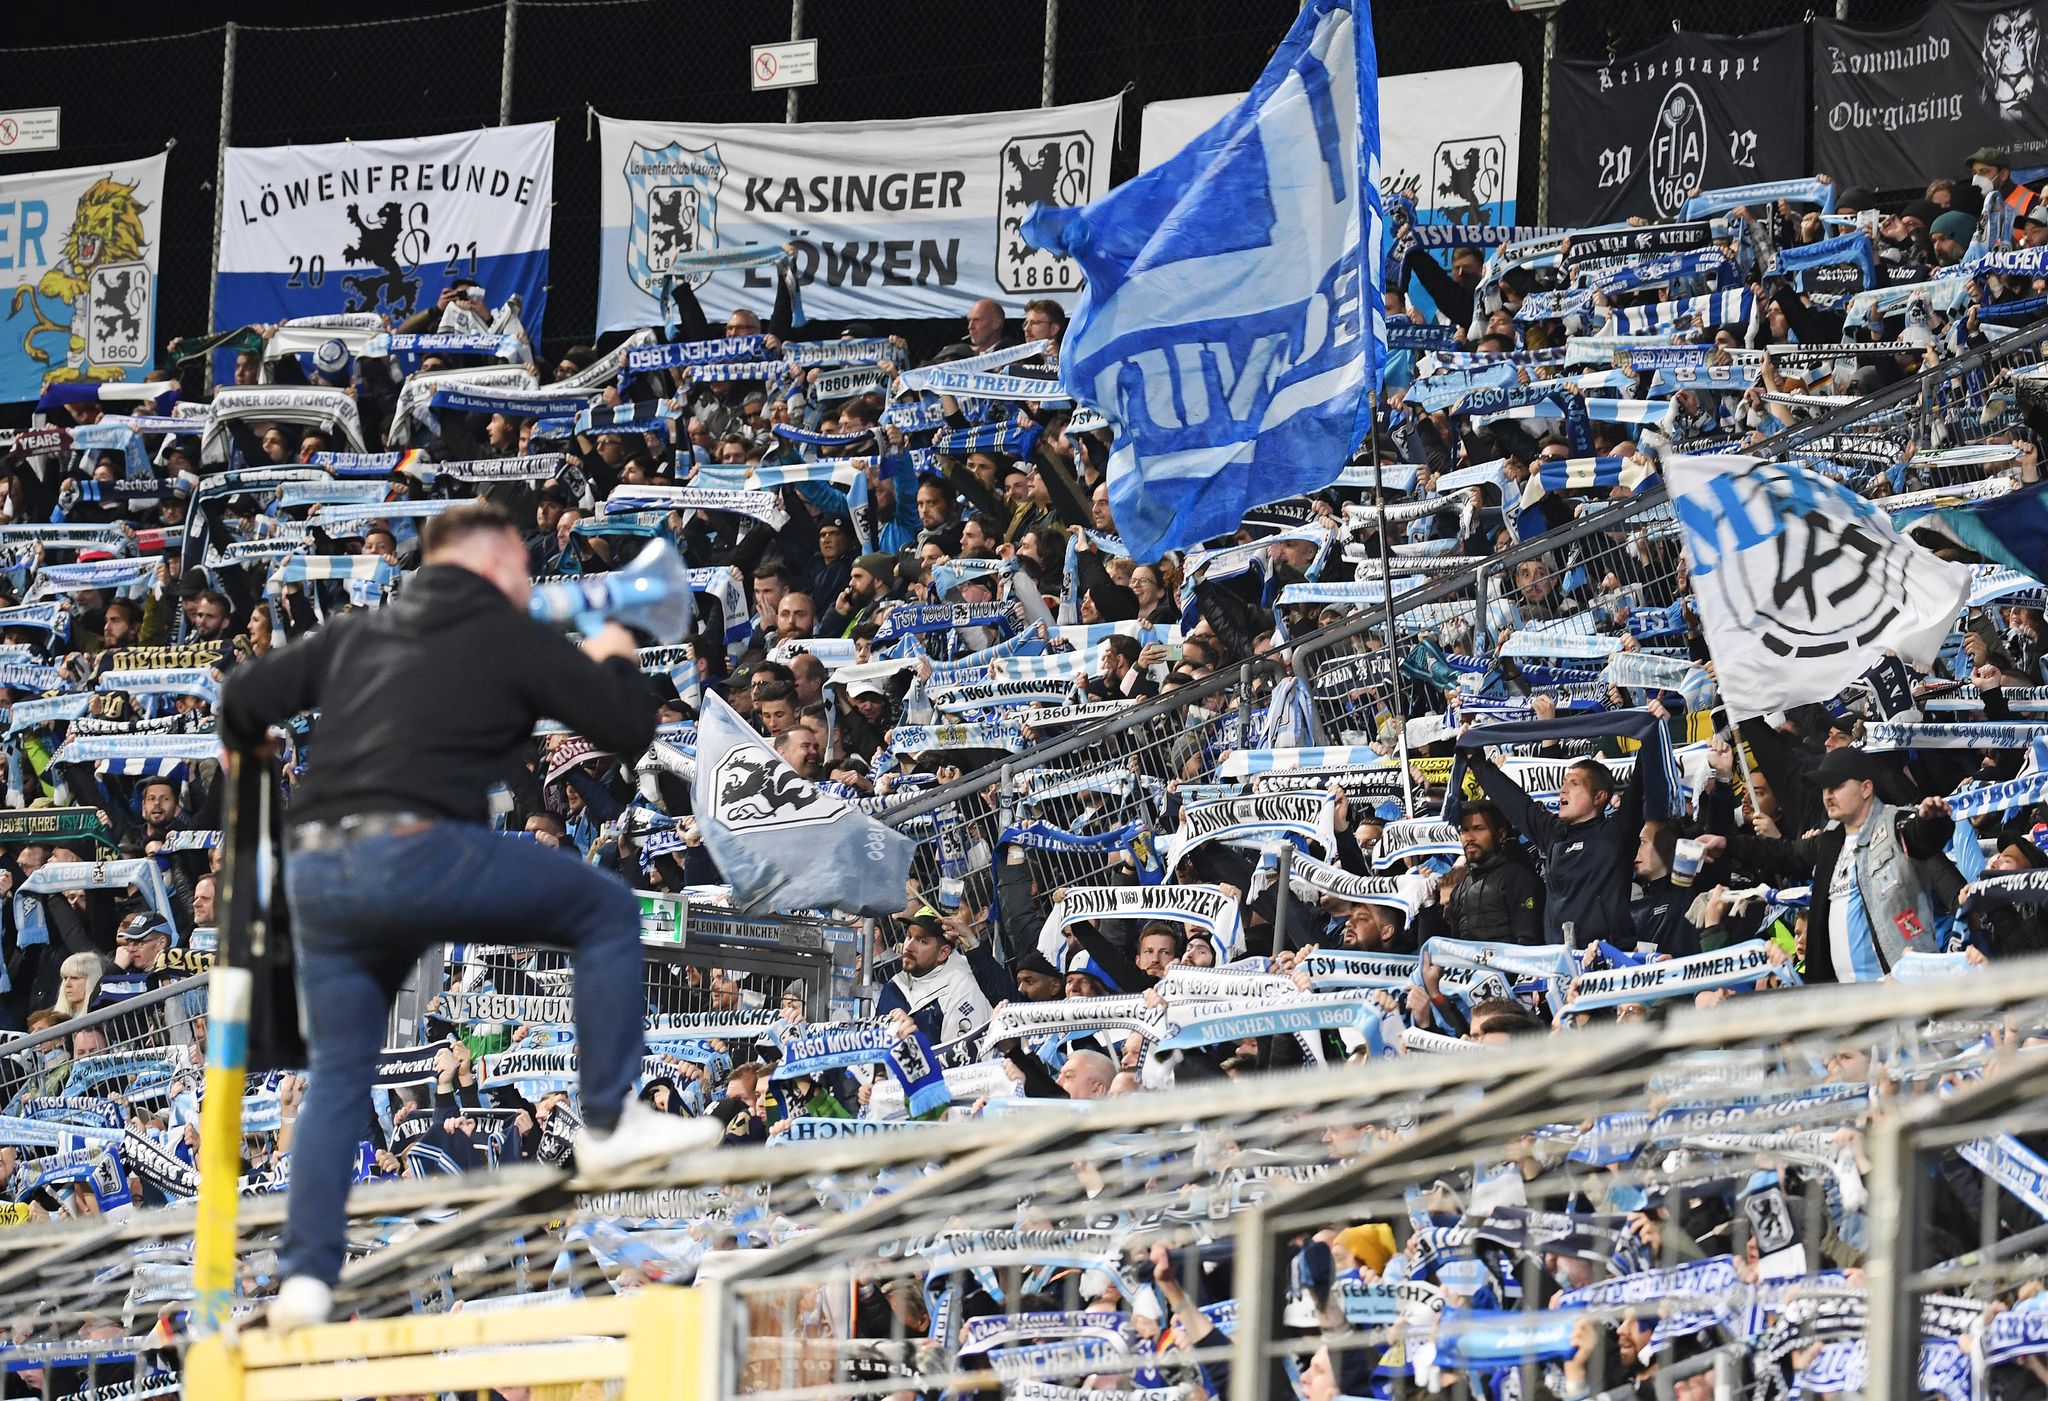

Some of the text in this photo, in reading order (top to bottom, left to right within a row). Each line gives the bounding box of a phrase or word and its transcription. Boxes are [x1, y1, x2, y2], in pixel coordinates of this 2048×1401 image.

[1828, 36, 1951, 76] Kommando
[1597, 55, 1761, 93] Reisegruppe
[1828, 93, 1963, 132] Obergiasing
[1598, 144, 1633, 189] 20
[241, 163, 535, 226] LÖWENFREUNDE
[743, 170, 966, 213] KASINGER
[1415, 225, 1511, 247] TSV 1860
[287, 240, 479, 290] 20 21
[1011, 265, 1072, 288] 1860
[100, 345, 138, 360] 1860
[819, 370, 889, 393] 1860 MÜNC
[973, 375, 1047, 394] TREU ZU
[549, 401, 578, 413] Heimat
[18, 431, 62, 451] YEARS
[472, 459, 502, 476] NEVER
[502, 457, 529, 474] WALK
[892, 607, 918, 629] TSV
[1635, 610, 1667, 632] TS
[959, 683, 993, 703] 1860
[1034, 705, 1071, 722] 1860
[901, 733, 927, 749] 1860
[981, 725, 1022, 742] MÜNC
[1518, 764, 1565, 795] LEONU
[28, 815, 57, 836] JAHRE
[1185, 800, 1241, 841] LEONUM
[1063, 886, 1228, 923] EONUM 1860 MÜNCHEN
[695, 920, 780, 940] LEONUM MÜNCHEN
[1304, 957, 1336, 978] TSV
[1621, 969, 1665, 990] LÖWE
[1682, 959, 1734, 981] IMMER
[1739, 950, 1768, 971] LÖW
[467, 994, 520, 1020] 1860
[523, 995, 576, 1024] MÜN
[999, 1010, 1023, 1030] TSV
[1200, 1008, 1353, 1041] MÜNCHEN VON 1860
[663, 1045, 677, 1059] 1:0
[680, 1047, 694, 1061] 1:0
[790, 1039, 826, 1061] 1860
[378, 1055, 438, 1077] MÜNCHE
[1682, 1105, 1745, 1132] 1860
[839, 1358, 921, 1379] Münch
